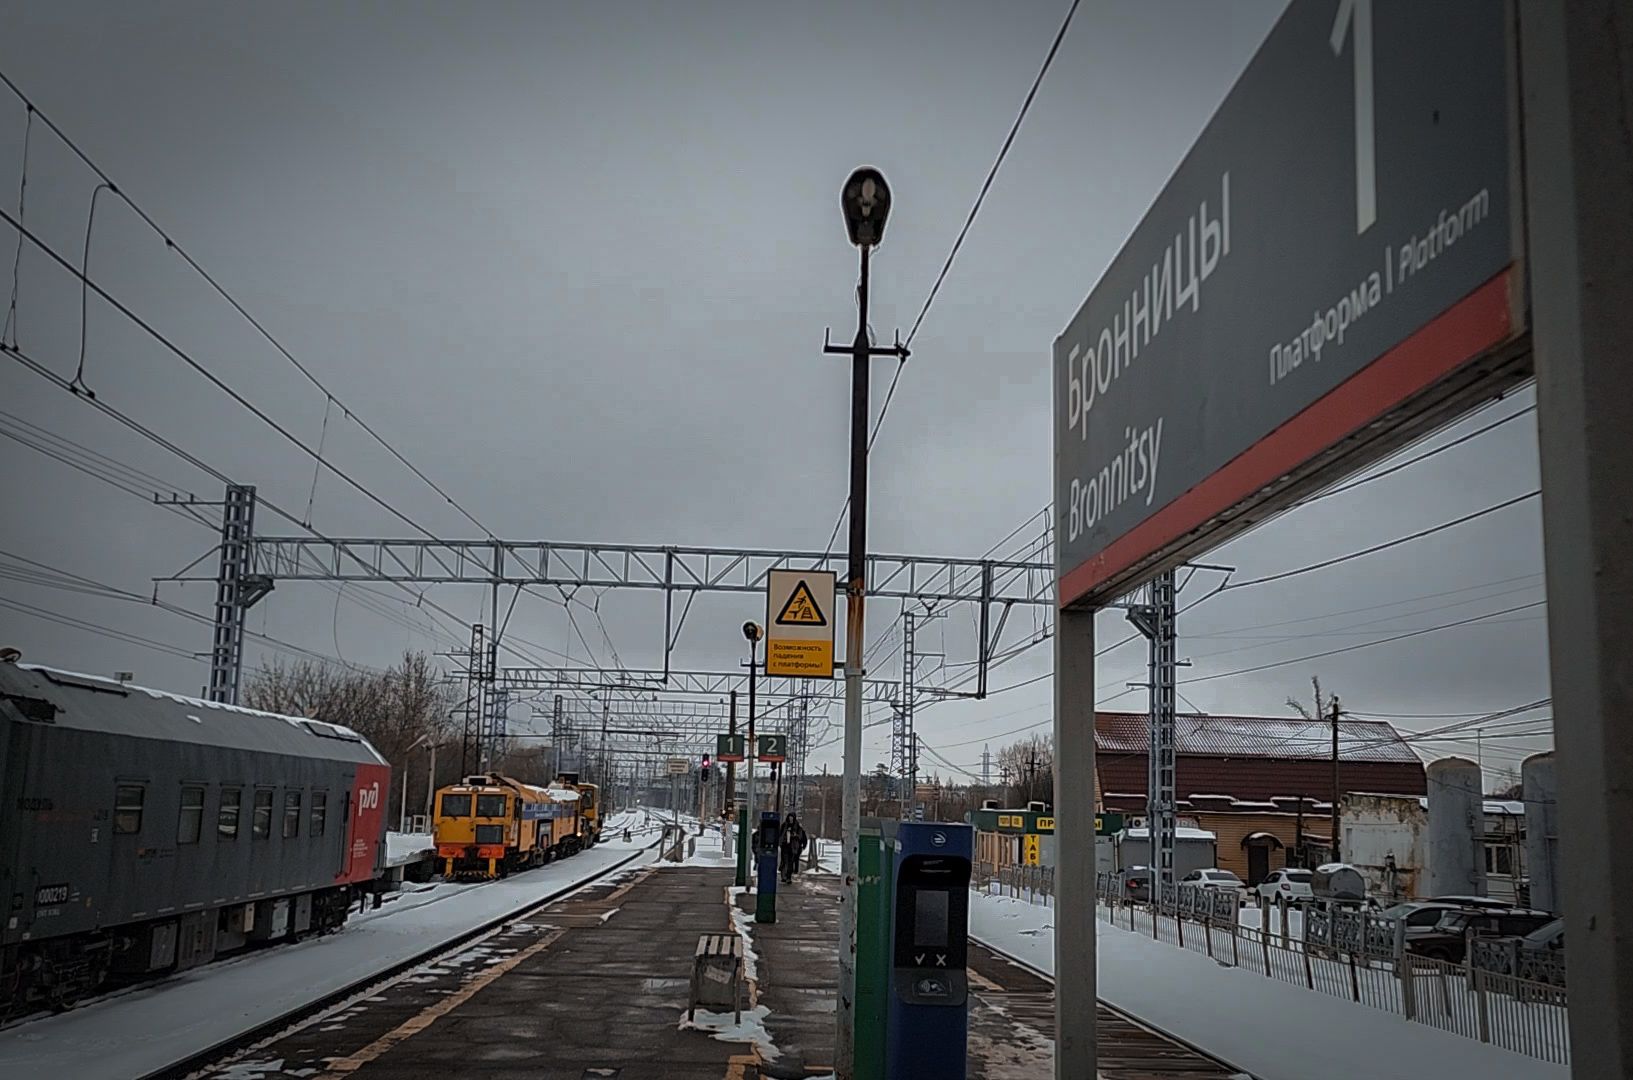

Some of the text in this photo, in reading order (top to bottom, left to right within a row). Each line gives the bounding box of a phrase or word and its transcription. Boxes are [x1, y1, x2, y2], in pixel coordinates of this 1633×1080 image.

[1330, 0, 1376, 235] 1
[1068, 171, 1230, 440] Бронницы
[1269, 187, 1489, 385] Платформа Platform
[1068, 417, 1163, 543] Bronnitsy
[774, 643, 822, 652] Возможность
[778, 661, 823, 669] платформы!
[727, 737, 734, 752] 1
[767, 737, 777, 752] 2
